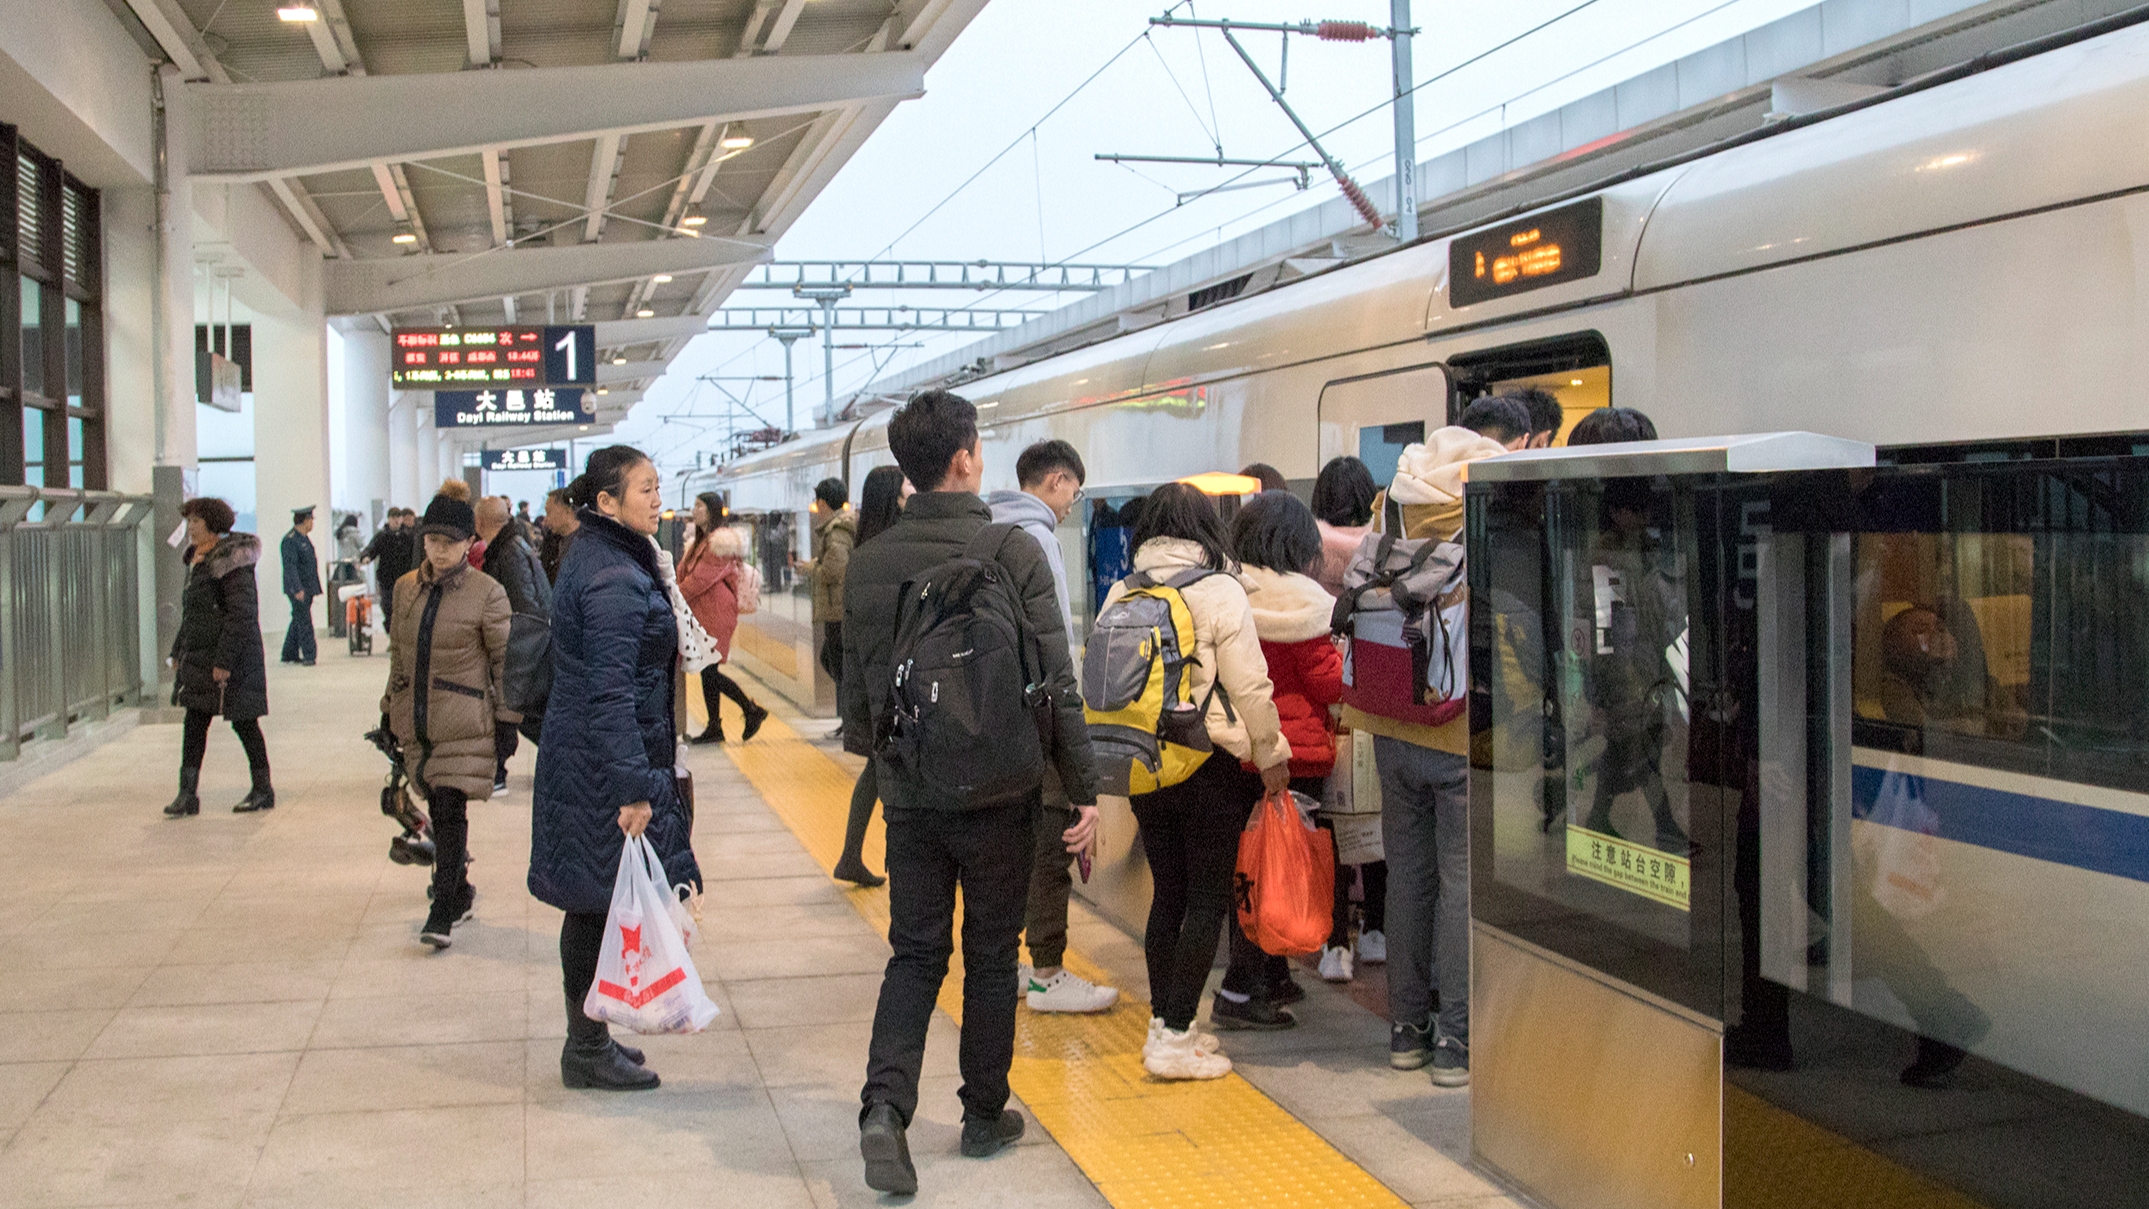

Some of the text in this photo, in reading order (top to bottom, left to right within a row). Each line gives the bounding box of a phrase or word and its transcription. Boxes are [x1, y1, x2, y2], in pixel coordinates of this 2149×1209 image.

[555, 330, 577, 381] 1
[476, 388, 555, 411] 大邑站
[456, 409, 575, 425] Dayi Railway Station
[1571, 854, 1588, 866] Please
[1588, 859, 1603, 871] mind
[1603, 862, 1613, 874] the
[1613, 868, 1623, 879] gap
[1624, 870, 1649, 887] between
[1649, 878, 1659, 890] the
[1660, 883, 1675, 895] train
